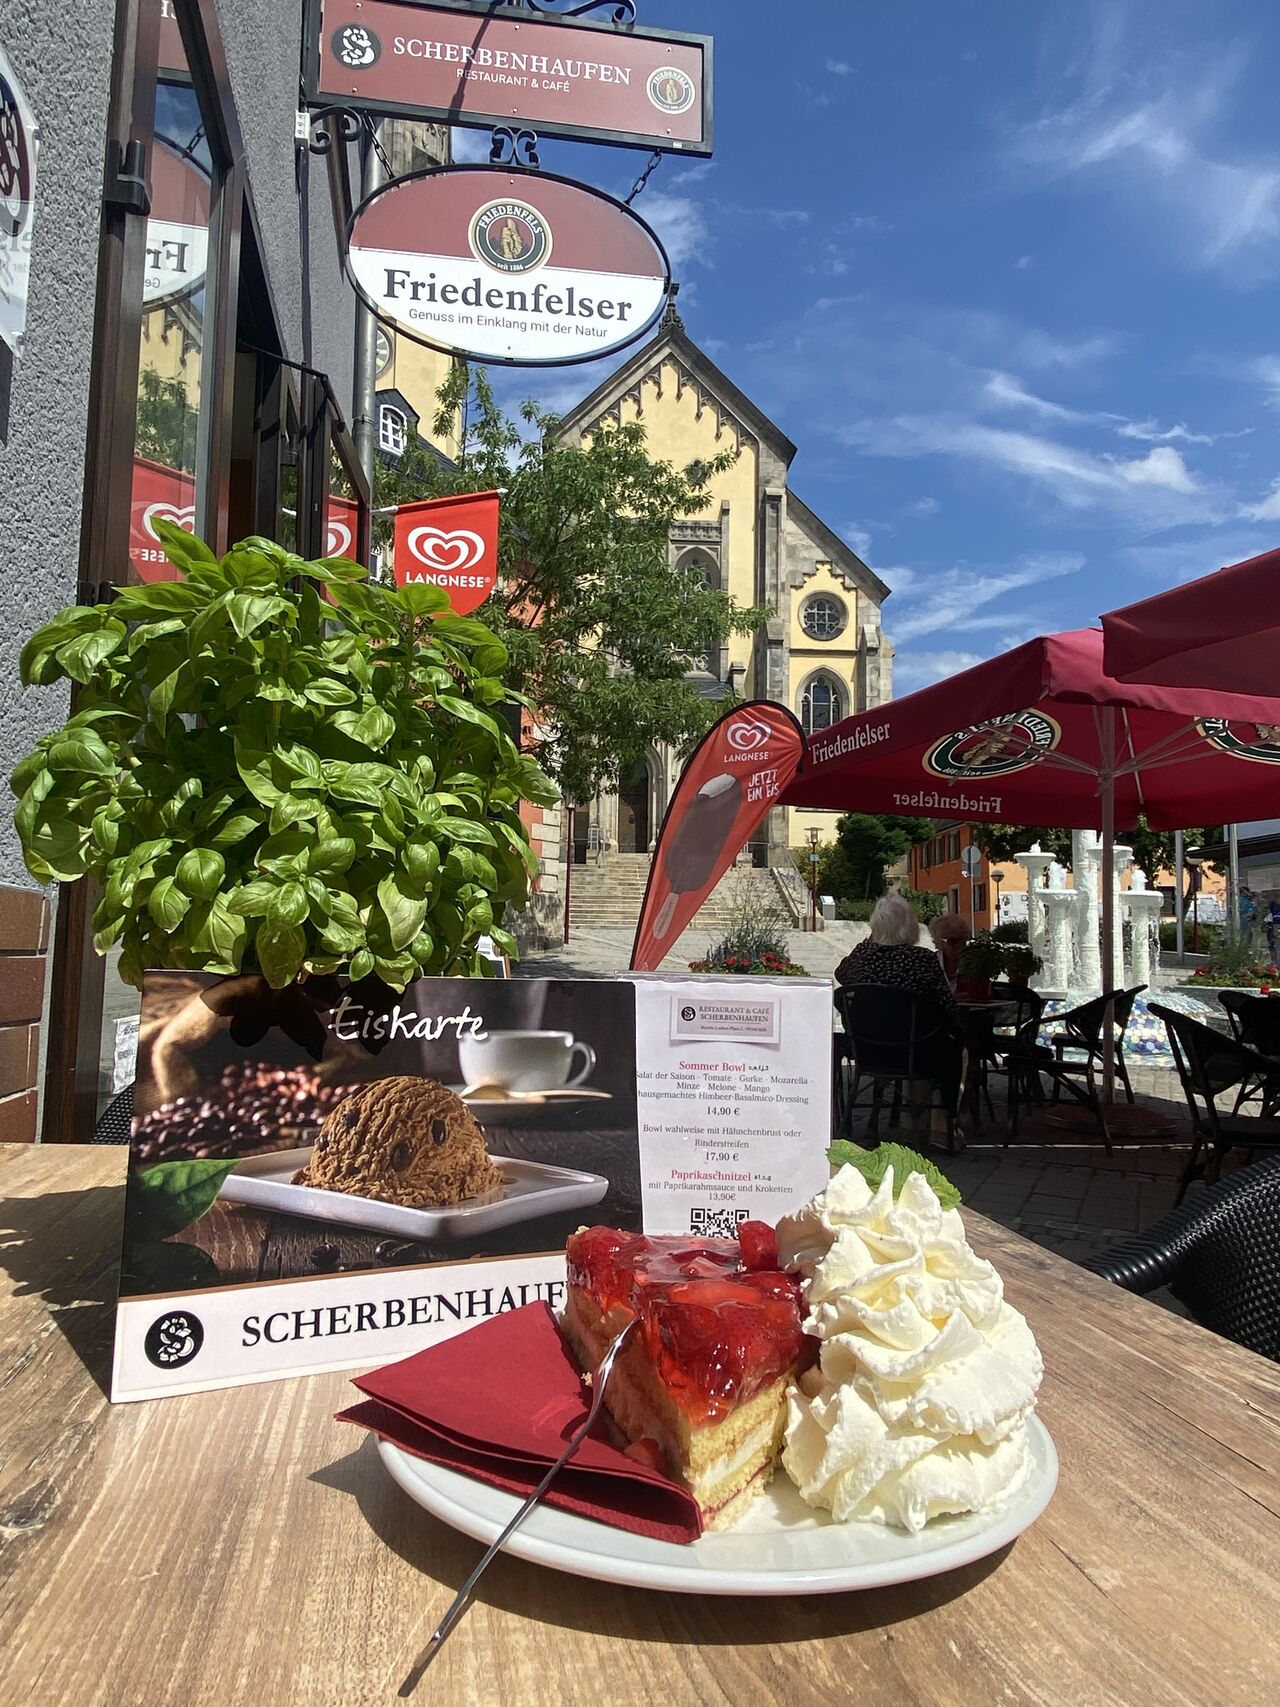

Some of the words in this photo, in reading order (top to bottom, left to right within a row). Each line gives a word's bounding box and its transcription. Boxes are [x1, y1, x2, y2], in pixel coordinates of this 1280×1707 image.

[393, 36, 632, 86] SCHERBENHAUFEN
[456, 68, 530, 88] RESTAURANT
[530, 78, 539, 89] &
[542, 80, 571, 93] CAFÉ
[477, 204, 544, 235] FRIEDENFELS
[383, 268, 633, 322] Friedenfelser
[409, 308, 455, 324] Genuss
[458, 312, 474, 325] im
[477, 315, 528, 333] Einklang
[530, 321, 550, 333] mit
[552, 322, 572, 335] der
[575, 325, 608, 338] Natur
[811, 722, 891, 766] Friedenfelser
[723, 751, 770, 763] LANGNESE
[748, 768, 778, 788] JETZT
[679, 1061, 720, 1072] Sommer
[722, 1062, 746, 1073] Bowl
[655, 1071, 668, 1080] der
[670, 1072, 696, 1081] Saison
[703, 1073, 732, 1082] Tomate
[739, 1074, 763, 1083] Gurke
[770, 1075, 808, 1085] Mozarella
[677, 1081, 700, 1090] Minze
[708, 1082, 737, 1091] Melone
[744, 1084, 770, 1094] Mango
[638, 1090, 696, 1100] hausgemachtes
[707, 1106, 731, 1116] 14,90
[734, 1107, 740, 1116] €
[643, 1124, 662, 1133] Bowl
[665, 1125, 705, 1134] wahlweise
[722, 1126, 781, 1137] Hähnchenbrust
[784, 1129, 802, 1138] oder
[695, 1138, 750, 1149] Rinderstreifen
[705, 1151, 729, 1162] 17,90
[733, 1153, 739, 1161] €
[671, 1169, 752, 1182] Paprikaschnitzel
[648, 1181, 661, 1189] mit
[664, 1181, 735, 1193] Paprikarahmsauce
[738, 1184, 753, 1192] und
[755, 1185, 793, 1194] Kroketten
[242, 1280, 568, 1348] SCHERBENHAUF
